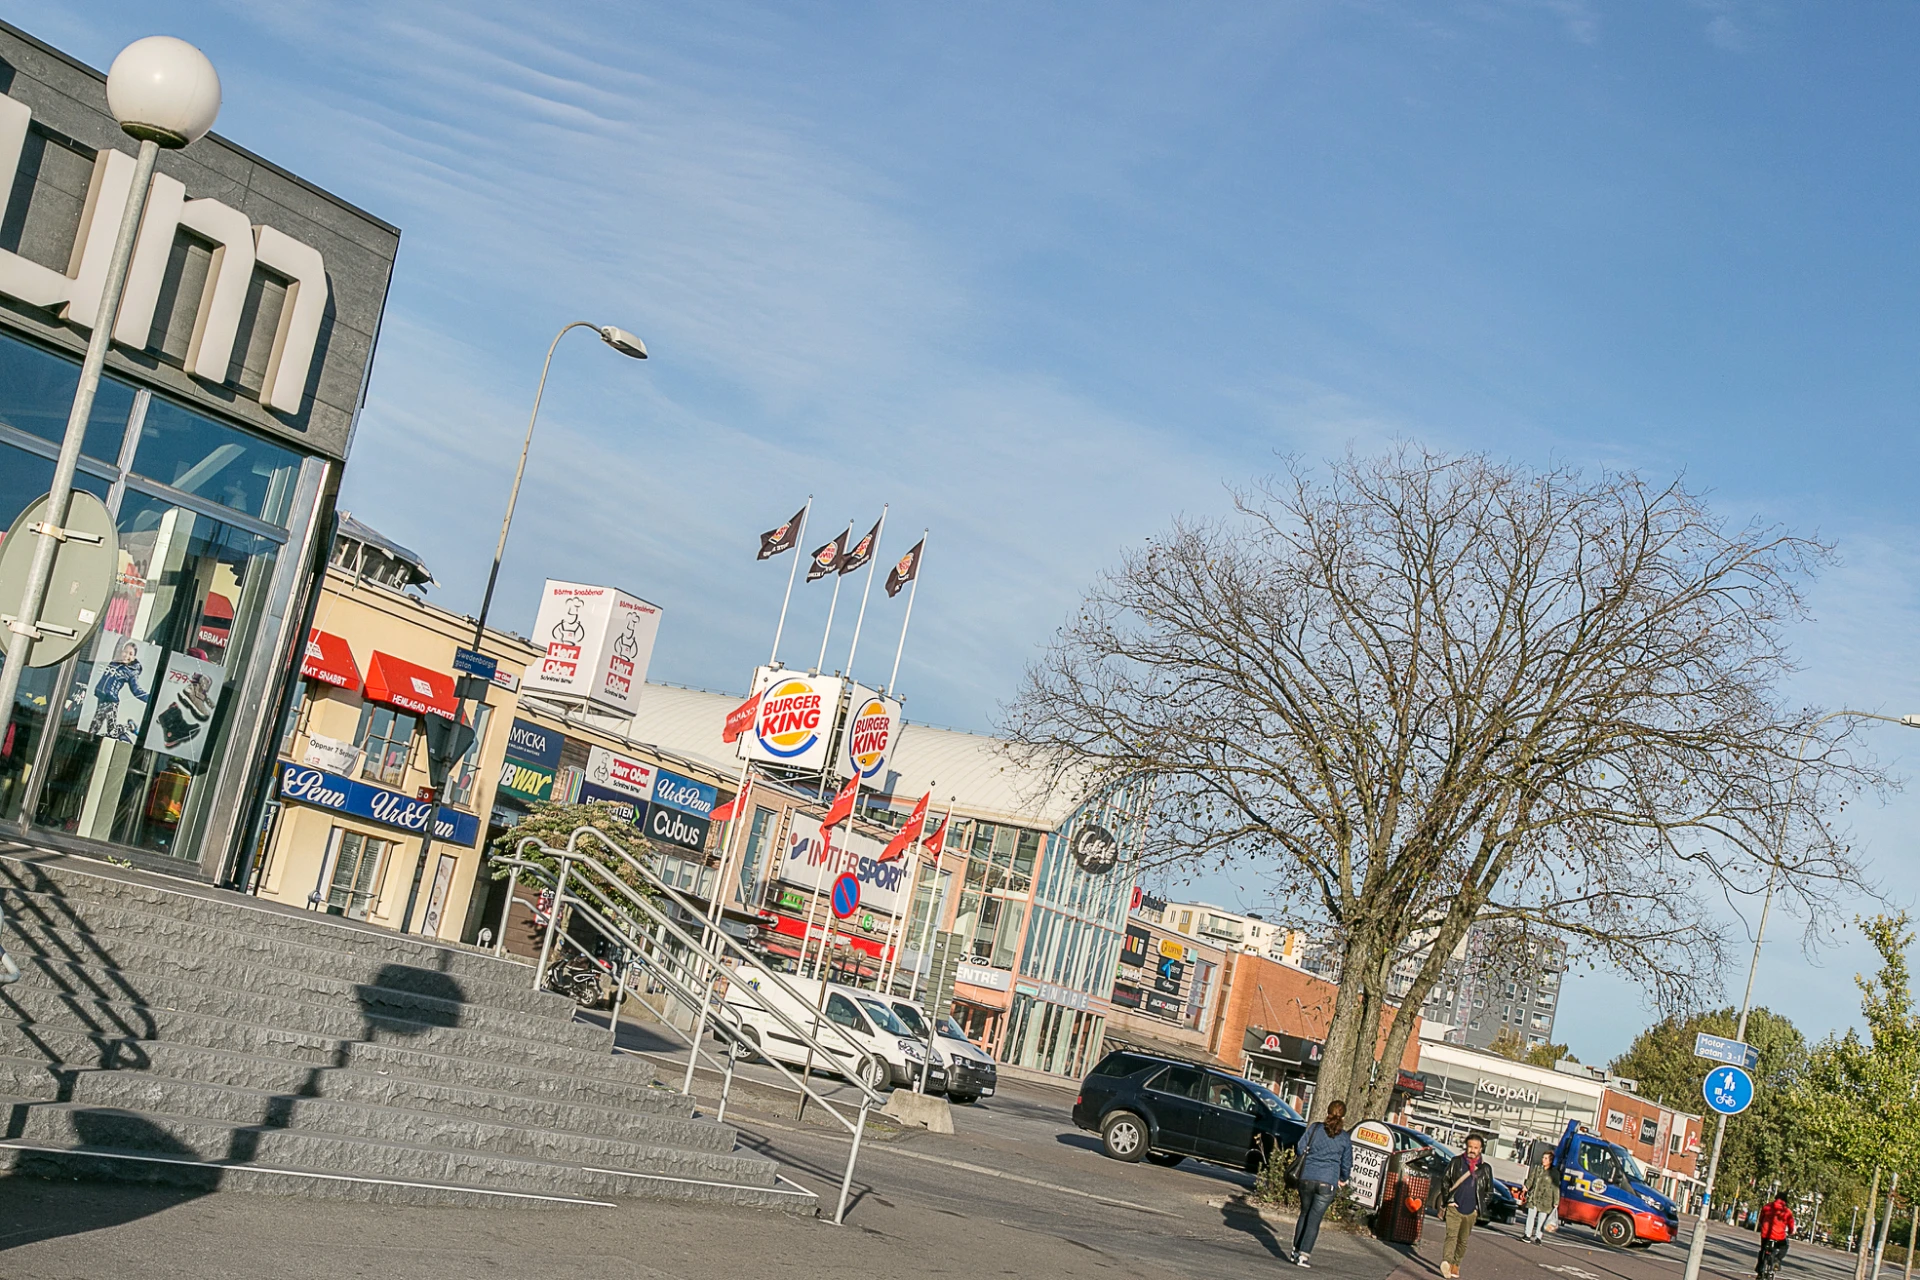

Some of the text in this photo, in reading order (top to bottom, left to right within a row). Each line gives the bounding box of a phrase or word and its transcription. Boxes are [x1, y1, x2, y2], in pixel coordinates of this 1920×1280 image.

[551, 644, 577, 659] Herr
[454, 660, 472, 670] gatan
[545, 660, 574, 676] Ober
[612, 659, 632, 675] Herr
[318, 670, 348, 686] SNABBT
[608, 675, 630, 693] Ober
[392, 693, 426, 712] HEMLAGAD
[762, 695, 821, 717] BURGER
[761, 709, 821, 738] KING
[854, 717, 890, 735] BURGER
[510, 726, 546, 752] MYCKA
[851, 731, 889, 757] KING
[657, 778, 712, 813] Ur&Penn
[653, 810, 700, 846] Cubus
[957, 966, 999, 986] ENTRÉ
[1040, 984, 1088, 1009] ENTRÉ
[1699, 1047, 1722, 1058] gatan
[1478, 1077, 1541, 1105] KappAhl
[1359, 1128, 1388, 1144] EDEL'S
[1354, 1153, 1381, 1168] FYND-
[1352, 1164, 1380, 1180] RISER
[1357, 1179, 1373, 1189] ALLT
